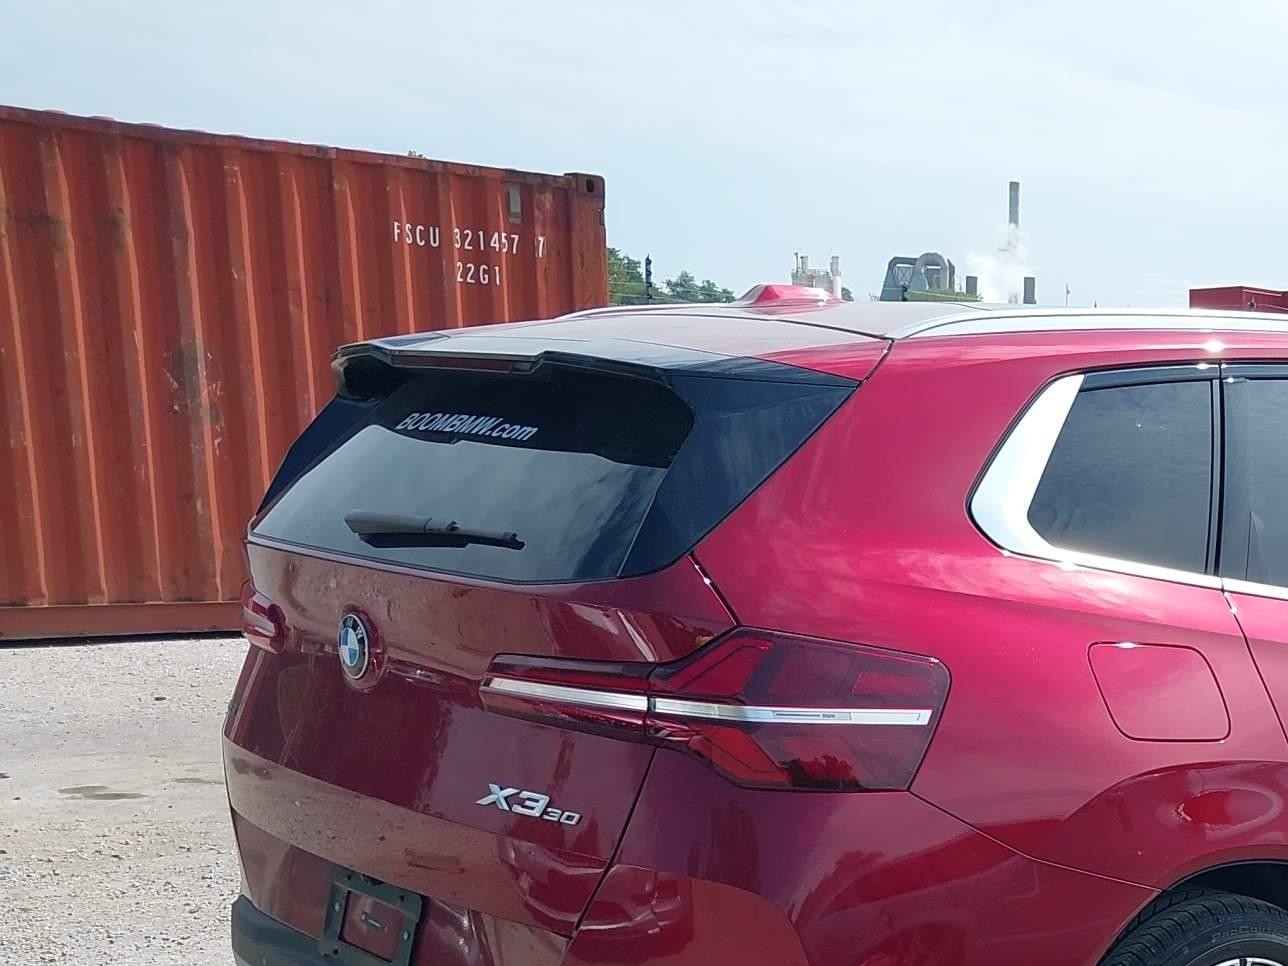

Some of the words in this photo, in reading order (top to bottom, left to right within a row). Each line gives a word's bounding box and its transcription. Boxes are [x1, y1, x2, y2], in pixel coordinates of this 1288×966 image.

[393, 221, 440, 248] FSCU
[454, 228, 519, 255] 321457
[536, 235, 546, 258] 7
[456, 261, 501, 286] 22G1
[395, 412, 538, 441] BOOMBMW.com
